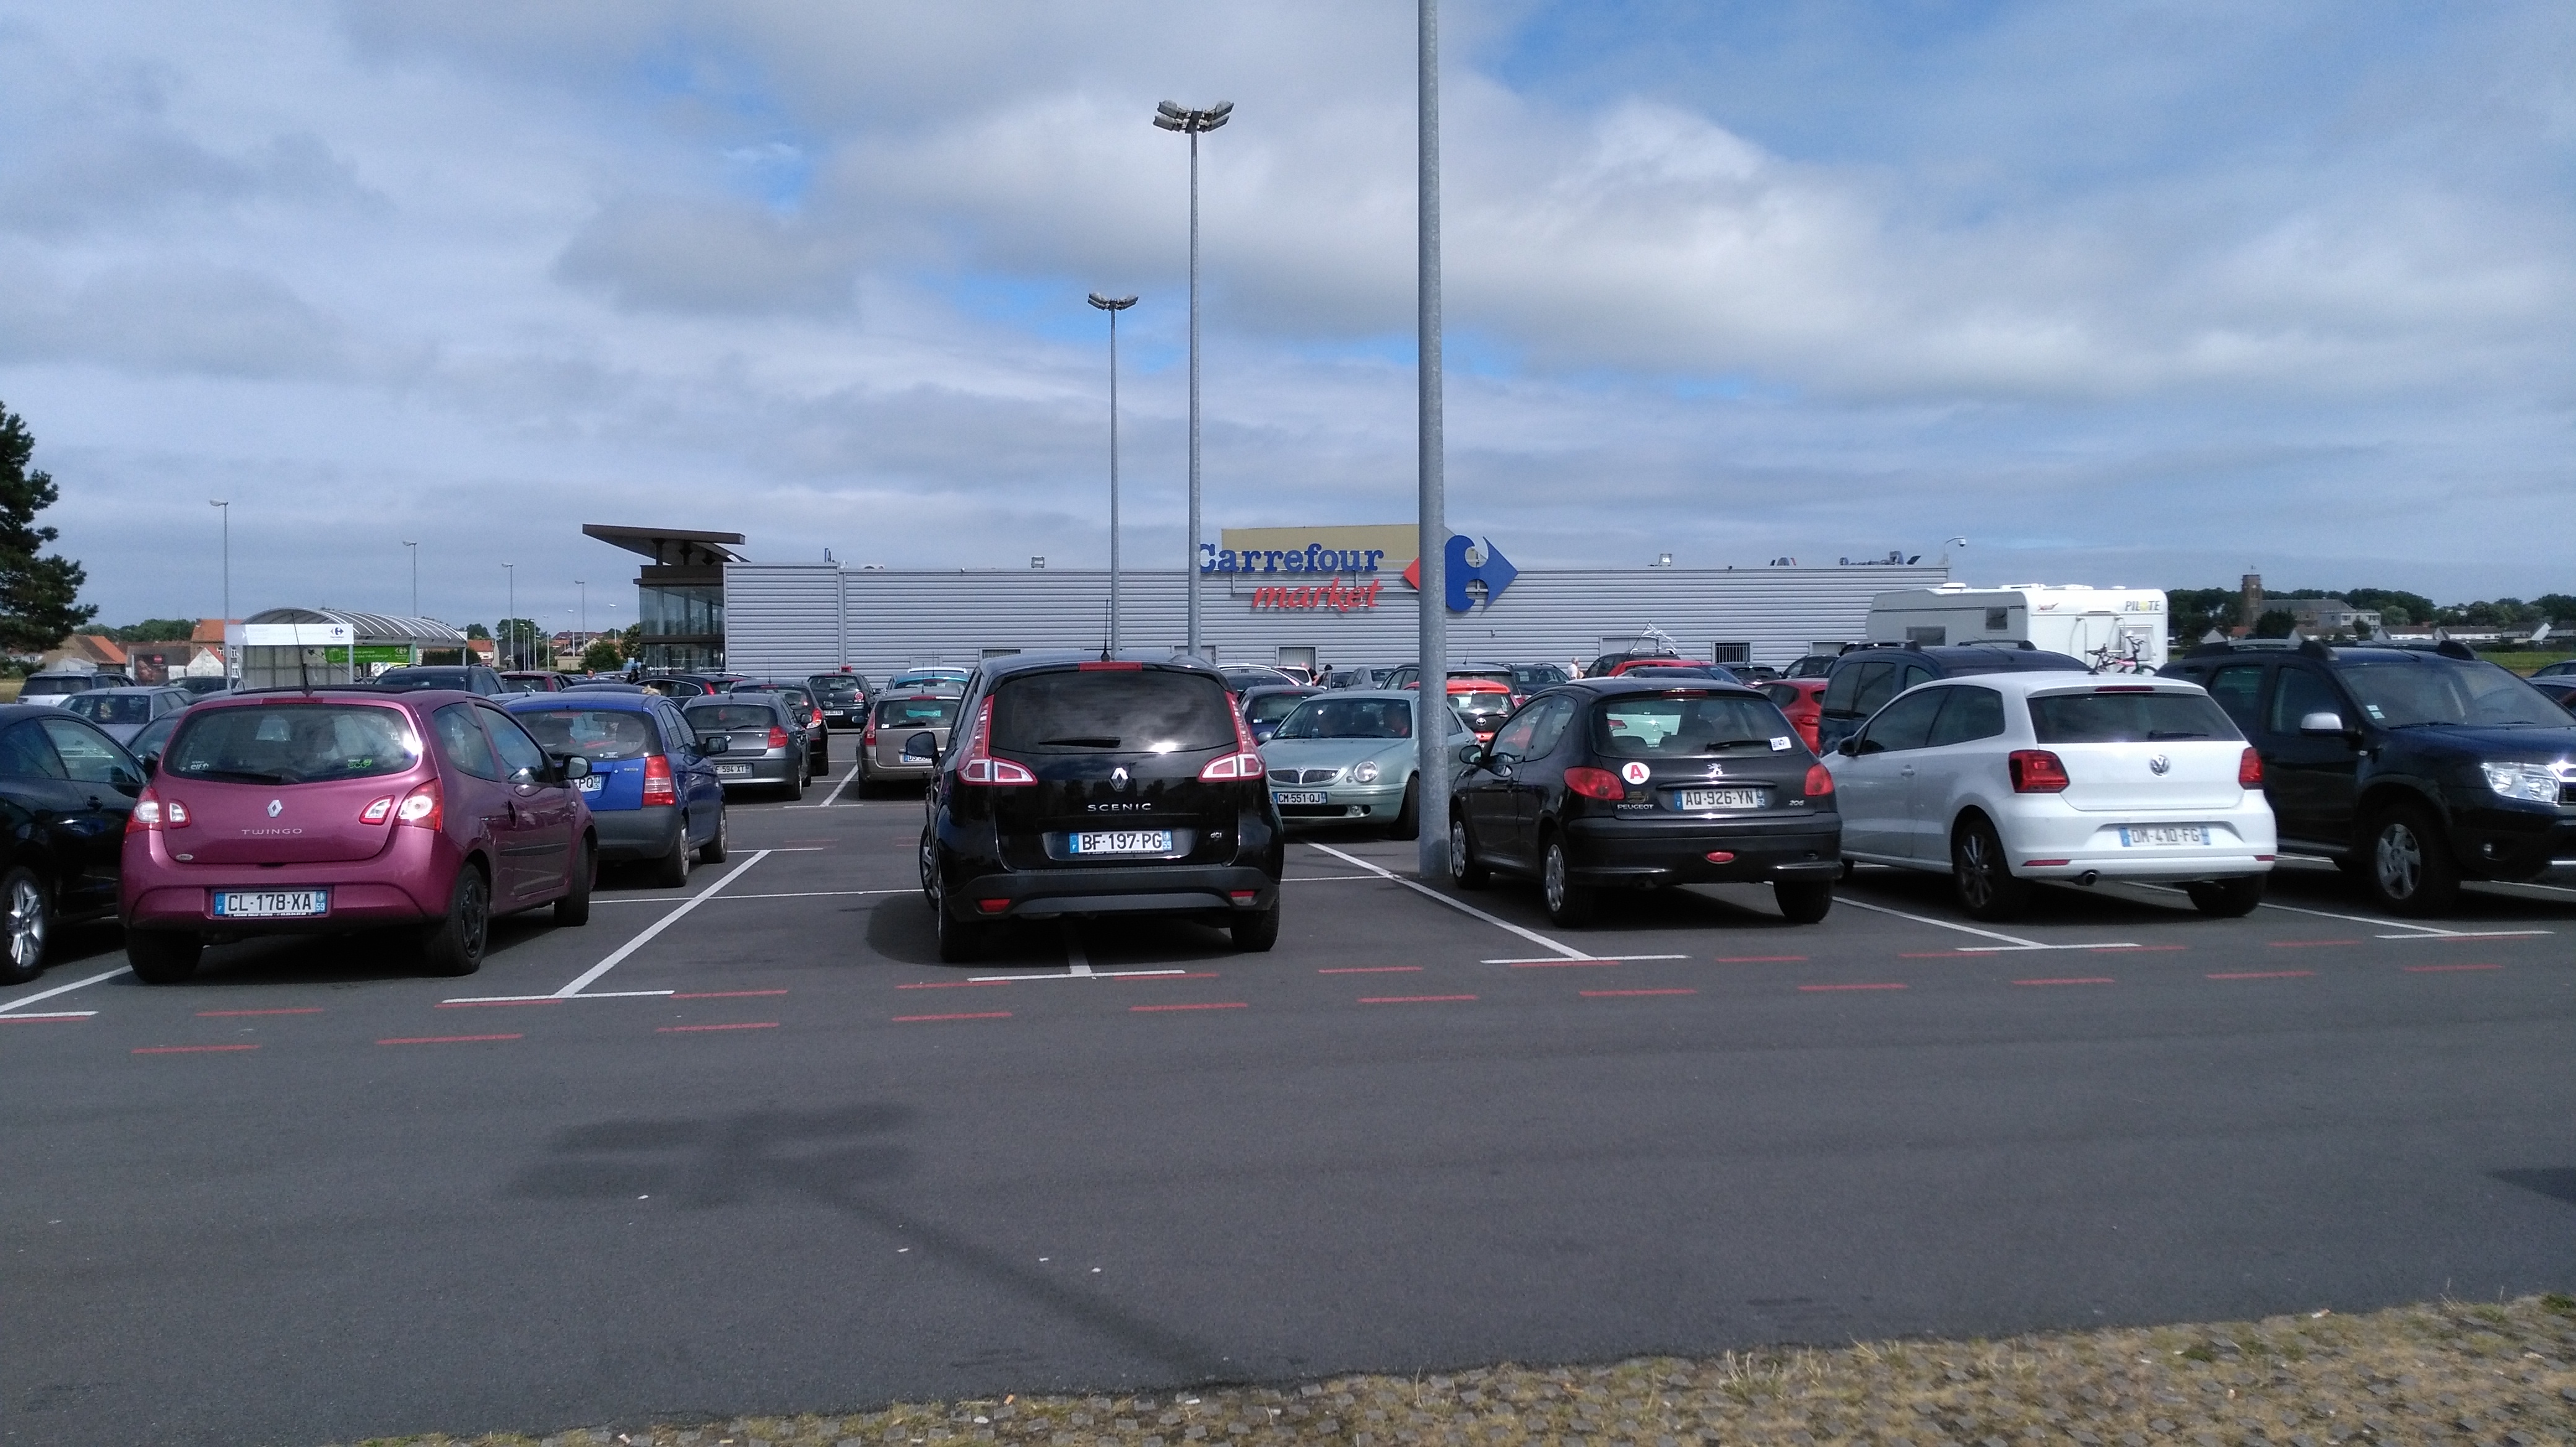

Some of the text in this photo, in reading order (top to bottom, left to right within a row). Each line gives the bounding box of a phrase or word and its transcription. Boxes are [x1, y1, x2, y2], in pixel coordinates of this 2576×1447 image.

[1200, 543, 1384, 572] Carrefour
[1252, 577, 1384, 612] market
[2125, 600, 2160, 611] PILOTE
[1630, 764, 1645, 780] A
[1278, 793, 1320, 803] CM-551-QJ
[1686, 790, 1754, 805] AQ-926-YN
[1087, 803, 1151, 811] SCENIC
[1082, 833, 1162, 850] BF-197-PG
[1163, 841, 1171, 849] 59
[228, 893, 312, 911] CL-178-XA
[316, 903, 326, 911] 59
